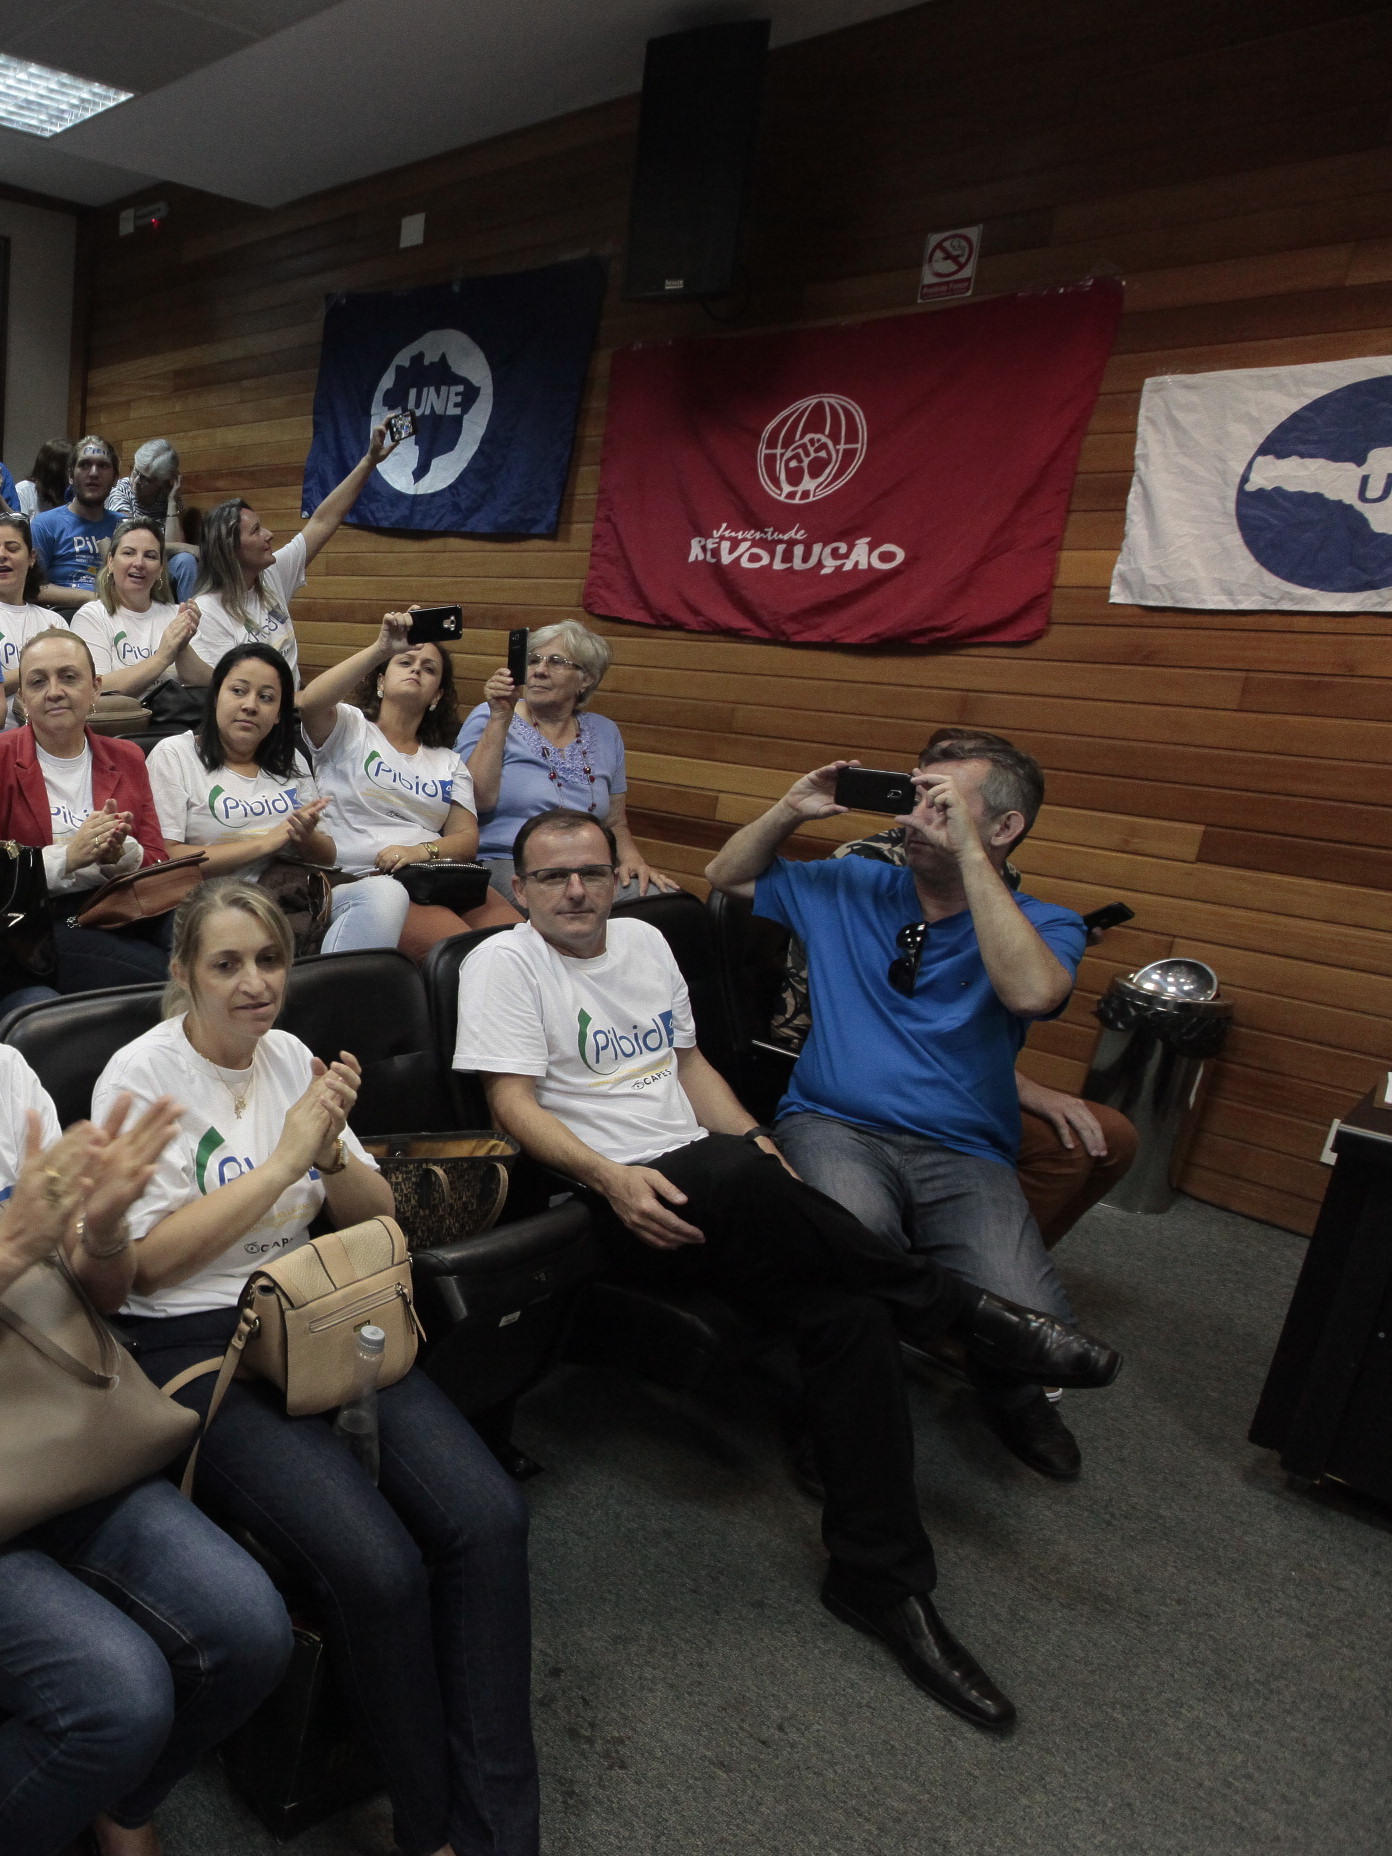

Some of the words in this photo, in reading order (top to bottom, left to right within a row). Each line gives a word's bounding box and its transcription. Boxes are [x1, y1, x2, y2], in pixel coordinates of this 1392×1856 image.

[407, 384, 465, 417] UNE
[712, 522, 809, 541] Juventude
[687, 536, 906, 575] REVOLUÇÃO
[374, 760, 439, 798] Pibid
[222, 791, 290, 820] Pibid
[592, 1017, 664, 1065] Pibid
[643, 1068, 673, 1086] CAPES
